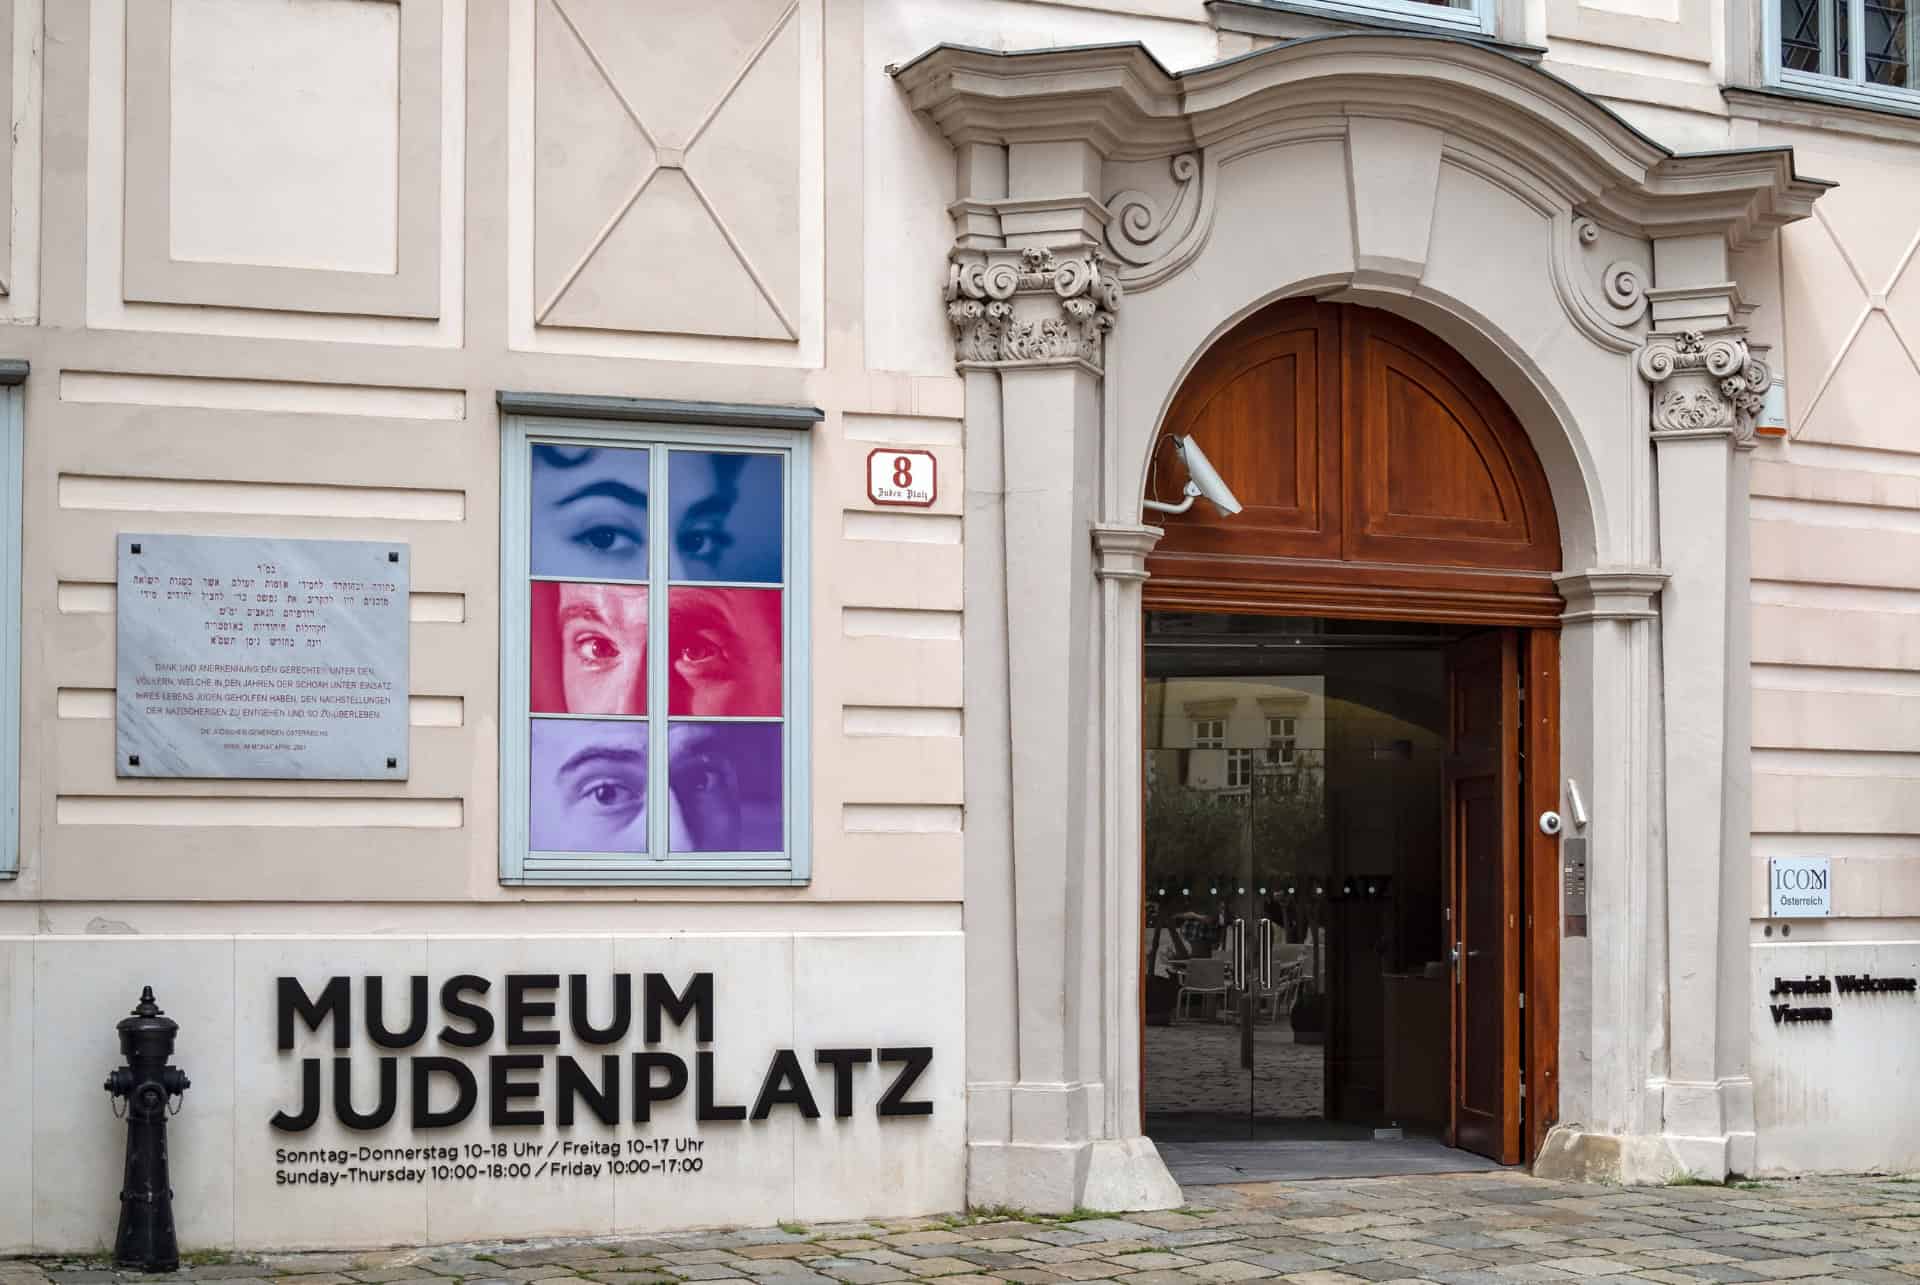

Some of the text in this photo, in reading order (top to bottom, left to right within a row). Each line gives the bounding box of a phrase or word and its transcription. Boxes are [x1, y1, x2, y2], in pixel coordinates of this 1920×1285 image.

[893, 456, 912, 488] 8
[177, 678, 211, 687] WELCHE
[242, 679, 275, 688] JAHREN
[276, 680, 293, 688] DER
[295, 680, 329, 689] SCHOAH
[330, 681, 357, 689] UNTER
[359, 681, 392, 690] EINSATZ
[162, 692, 194, 701] LEBENS
[224, 693, 268, 702] GEHOLFEN
[145, 706, 162, 715] DER
[1775, 869, 1827, 890] ICOM
[1780, 894, 1823, 906] Österreich
[1770, 974, 1917, 996] Jewish Welcome
[277, 973, 713, 1053] MUSEUM
[1770, 1003, 1832, 1024] Vienna
[269, 1047, 933, 1131] JUDENPLATZ
[275, 1146, 459, 1165] Sonntag-Donnerstag
[464, 1143, 508, 1158] 10-18
[514, 1142, 543, 1158] Uhr
[563, 1142, 621, 1158] Freitag
[627, 1139, 670, 1154] 10-17
[676, 1138, 705, 1153] Uhr
[275, 1166, 426, 1186] Sunday-Thursday
[431, 1164, 531, 1181] 10:00-18:00
[550, 1161, 603, 1178] Friday
[608, 1158, 704, 1175] 10:00-17:00
